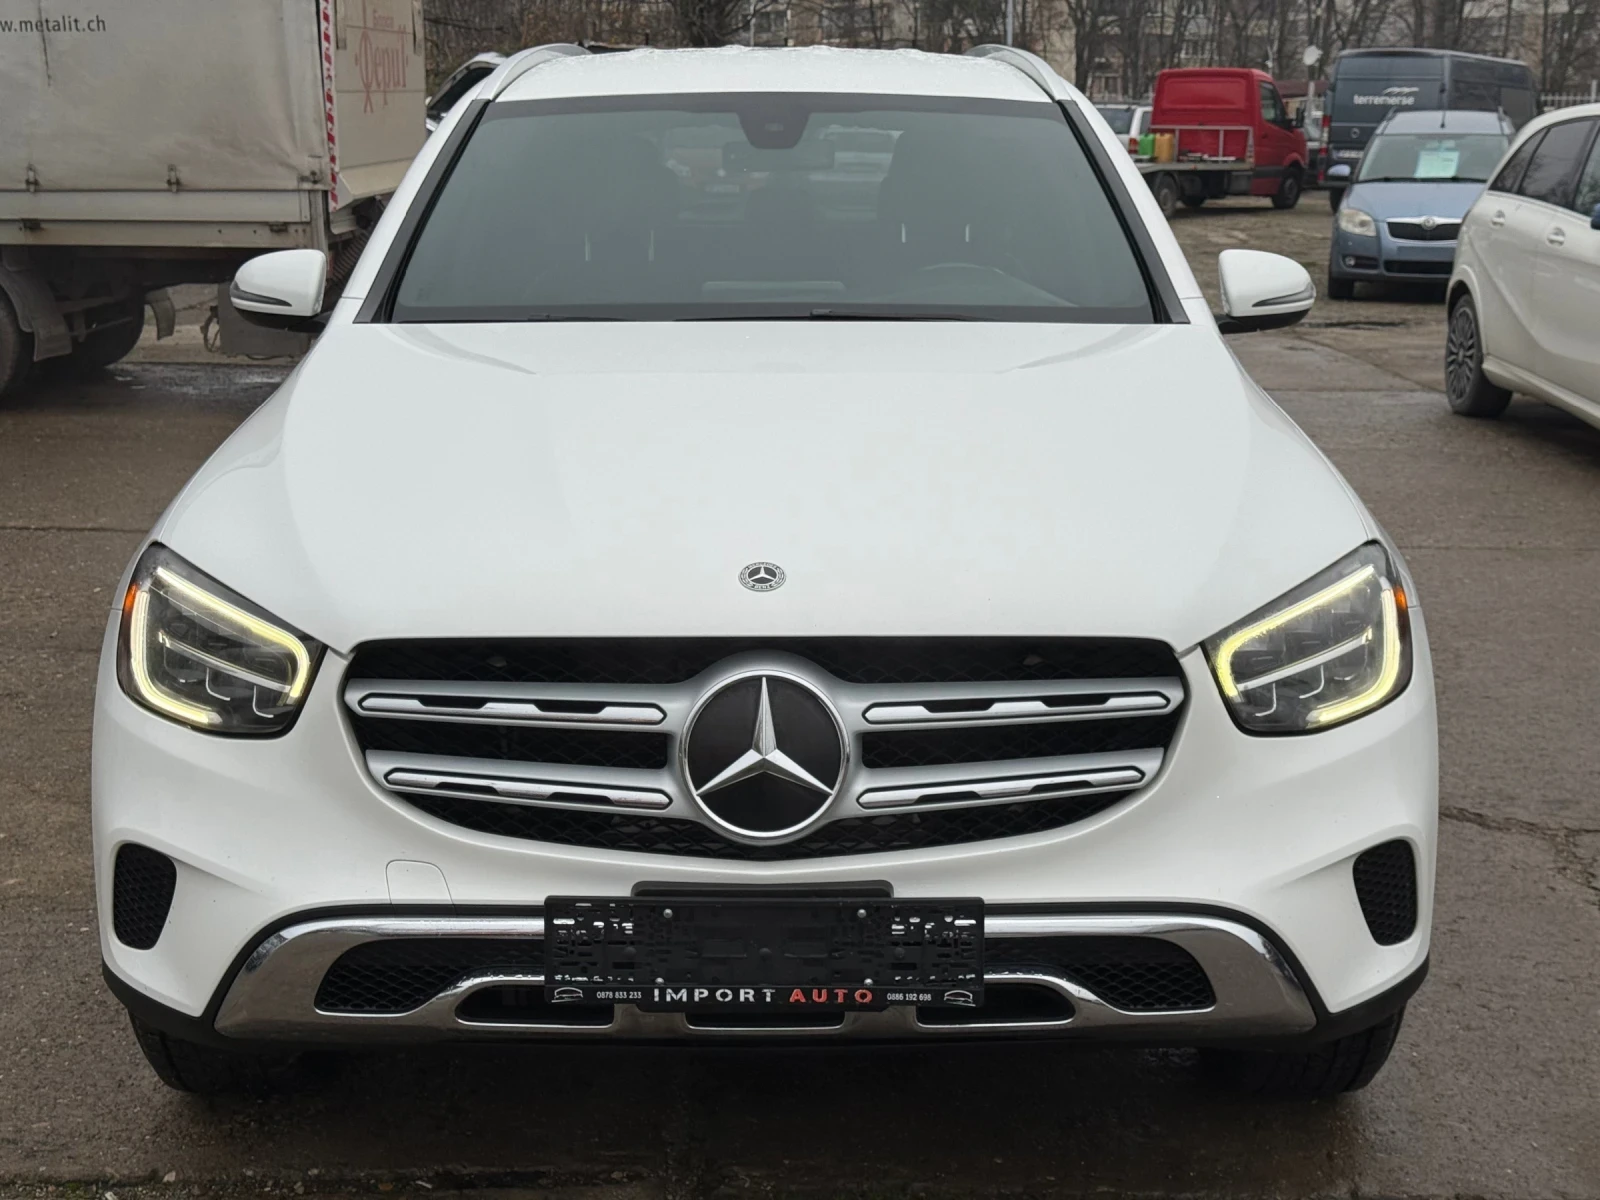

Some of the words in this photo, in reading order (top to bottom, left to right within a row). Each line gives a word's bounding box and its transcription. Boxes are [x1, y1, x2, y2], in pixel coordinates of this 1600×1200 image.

[596, 991, 614, 999] 0878
[614, 991, 628, 999] 833
[628, 991, 642, 999] 233
[653, 988, 776, 1003] IMPORT
[789, 988, 873, 1003] AUTO
[905, 992, 918, 1001] 192
[919, 992, 932, 1001] 698
